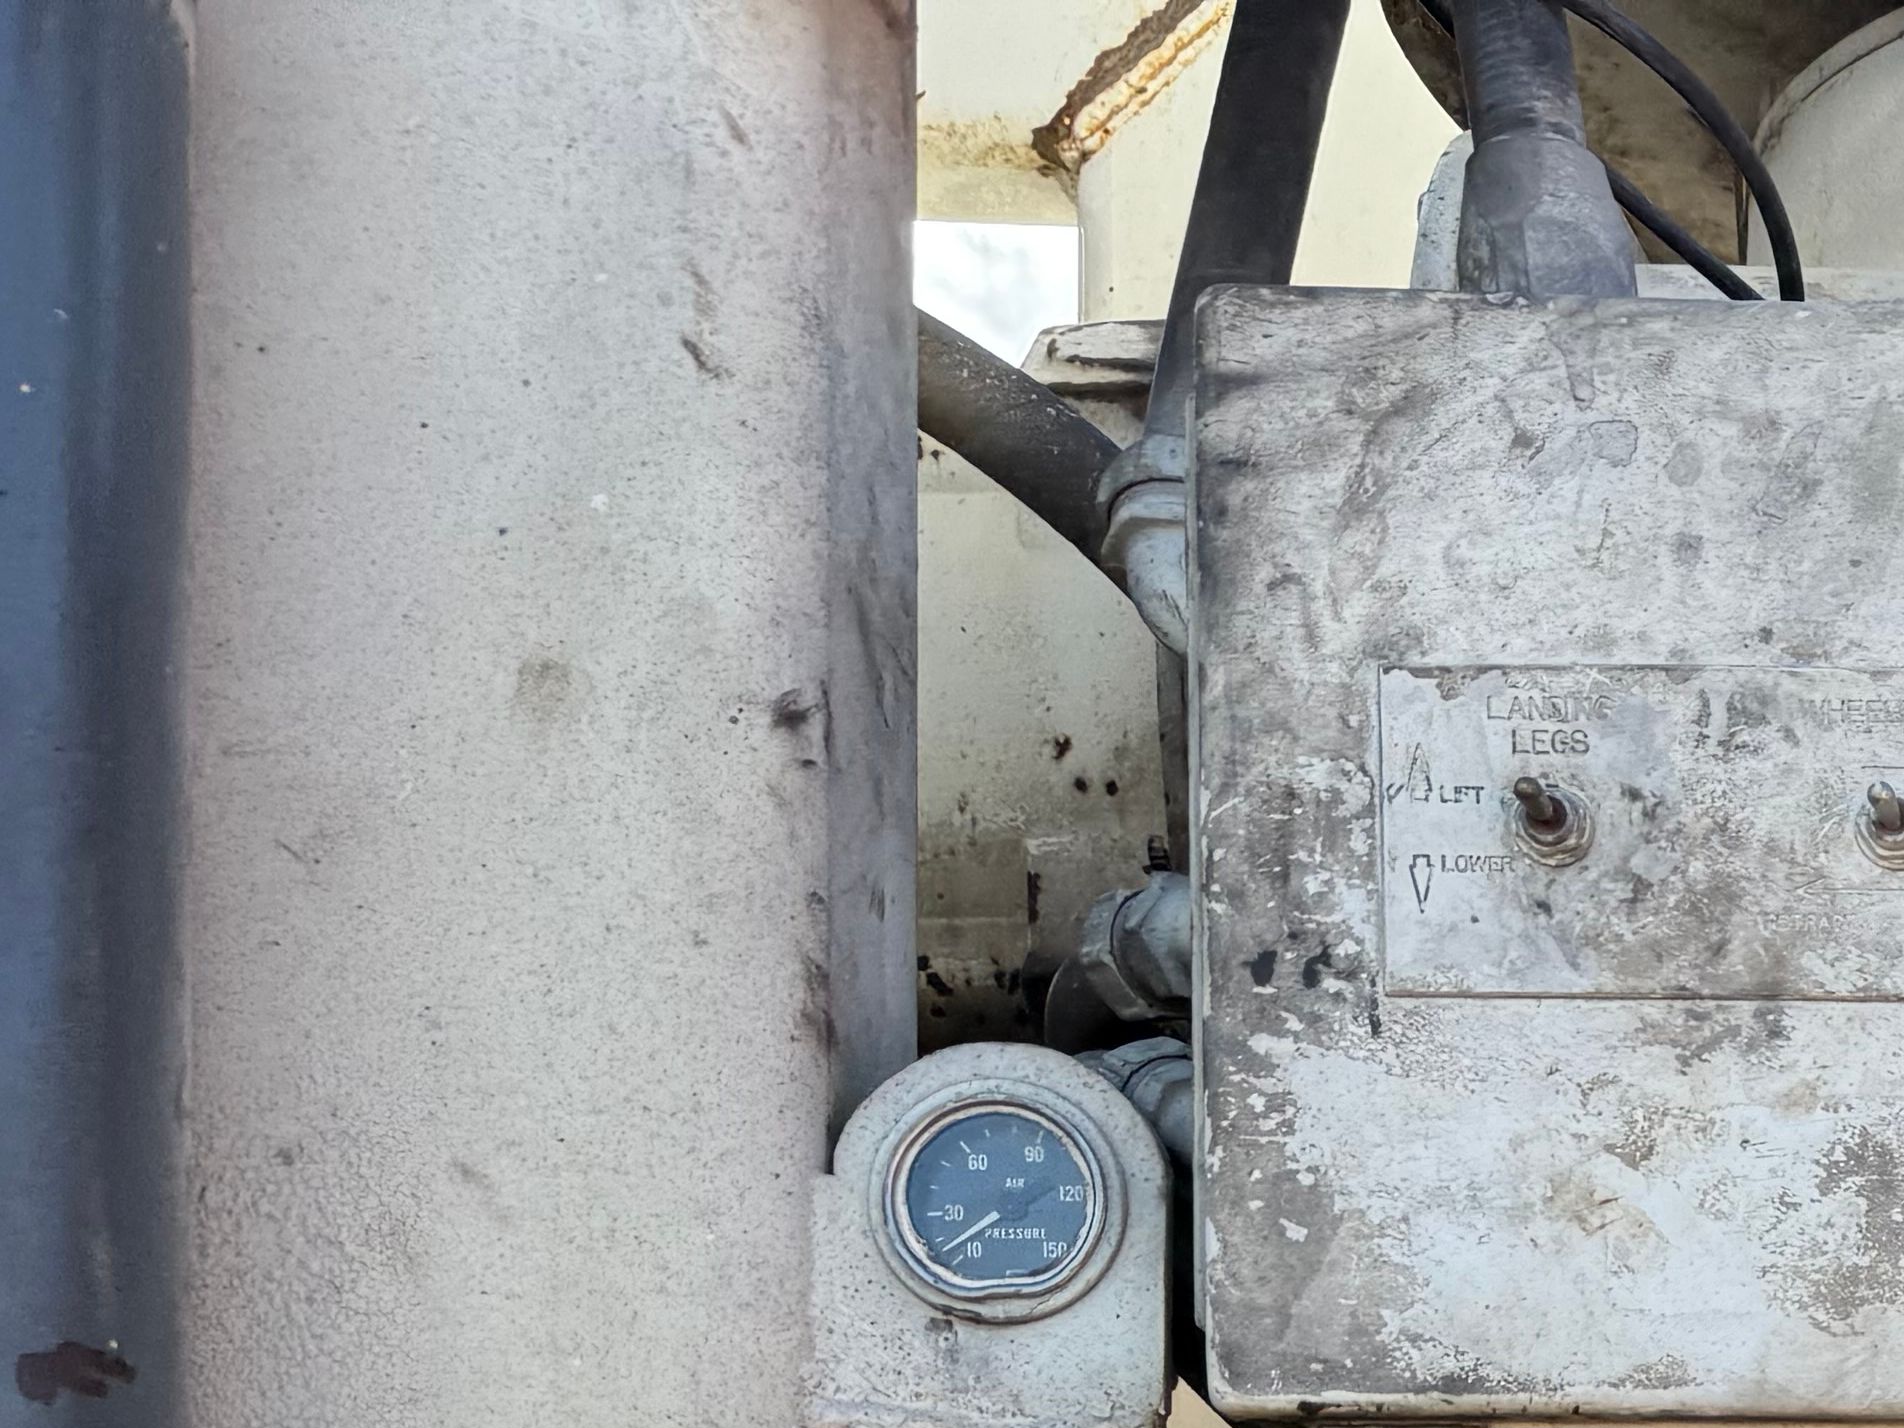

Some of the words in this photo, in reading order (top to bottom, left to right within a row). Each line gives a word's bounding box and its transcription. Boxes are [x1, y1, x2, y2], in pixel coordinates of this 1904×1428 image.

[1486, 694, 1617, 723] LANDING
[1511, 728, 1591, 754] LEGS
[1440, 854, 1516, 873] LOWER
[968, 1153, 987, 1171] 60
[1024, 1146, 1044, 1163] 90
[1005, 1177, 1025, 1188] AIR
[1059, 1185, 1083, 1201] 120
[944, 1204, 963, 1221] 30
[984, 1227, 1046, 1240] PRESSURE
[967, 1241, 982, 1258] 10
[1043, 1241, 1067, 1258] 150
